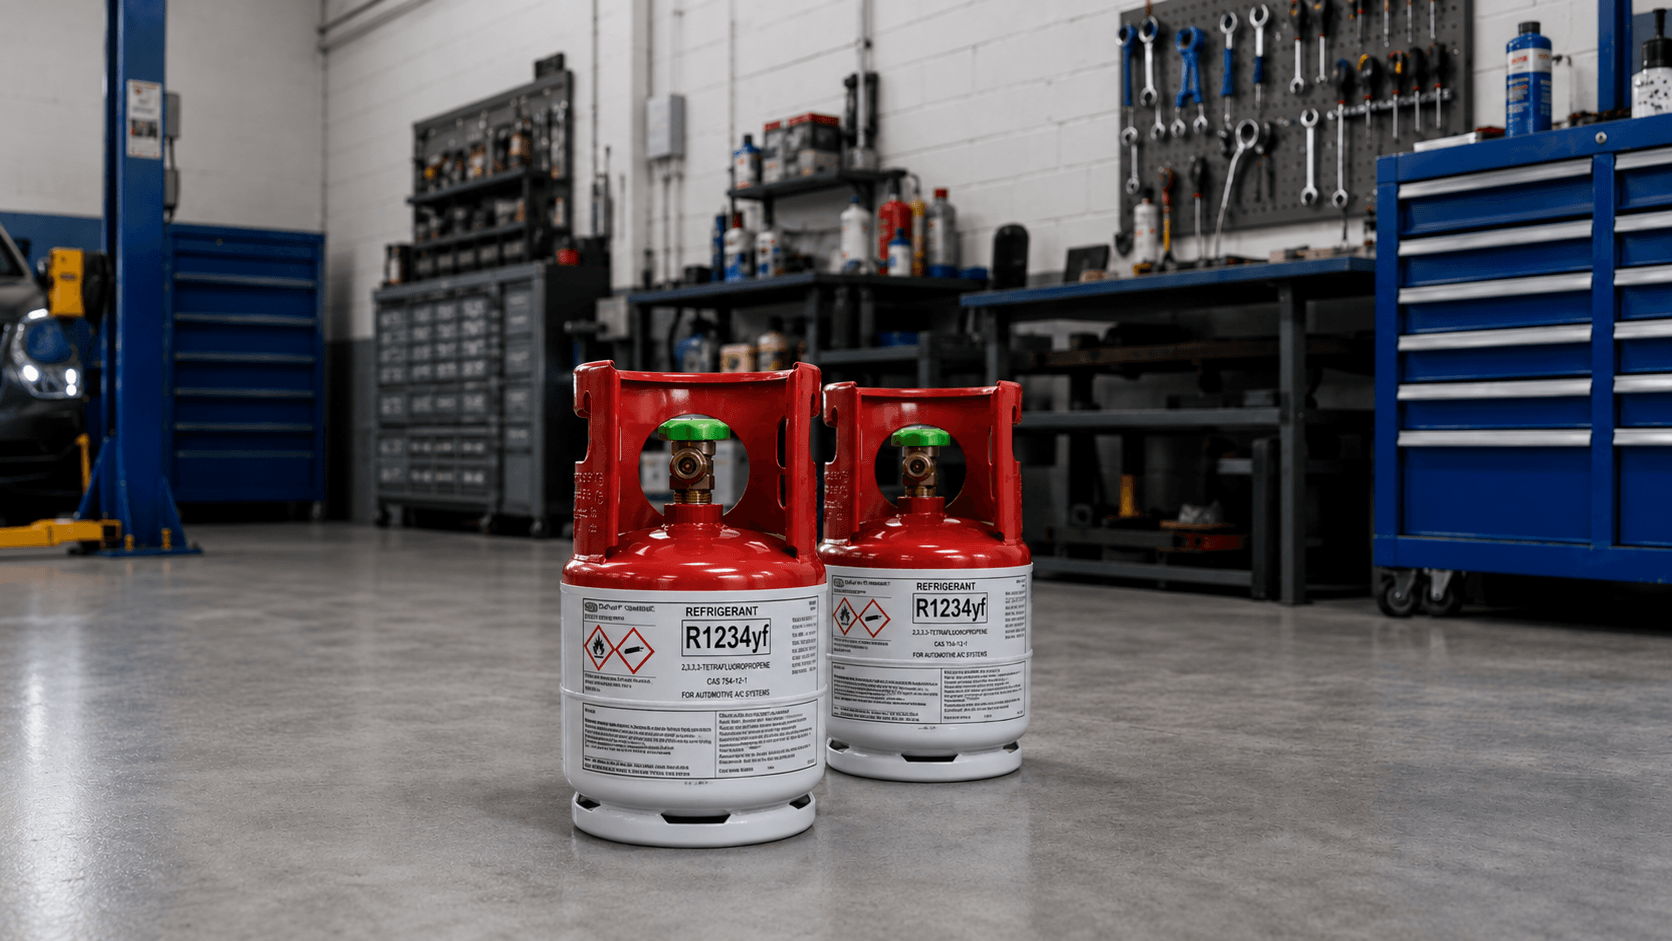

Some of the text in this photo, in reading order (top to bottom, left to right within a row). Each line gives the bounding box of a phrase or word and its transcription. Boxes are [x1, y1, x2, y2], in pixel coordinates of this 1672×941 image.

[917, 582, 976, 590] REFRIGERANT
[685, 606, 759, 617] REFRIGERANT
[916, 597, 986, 621] R1234yf
[685, 624, 769, 653] R1234yf
[706, 677, 720, 685] CAS
[745, 689, 770, 697] SYSTEMS
